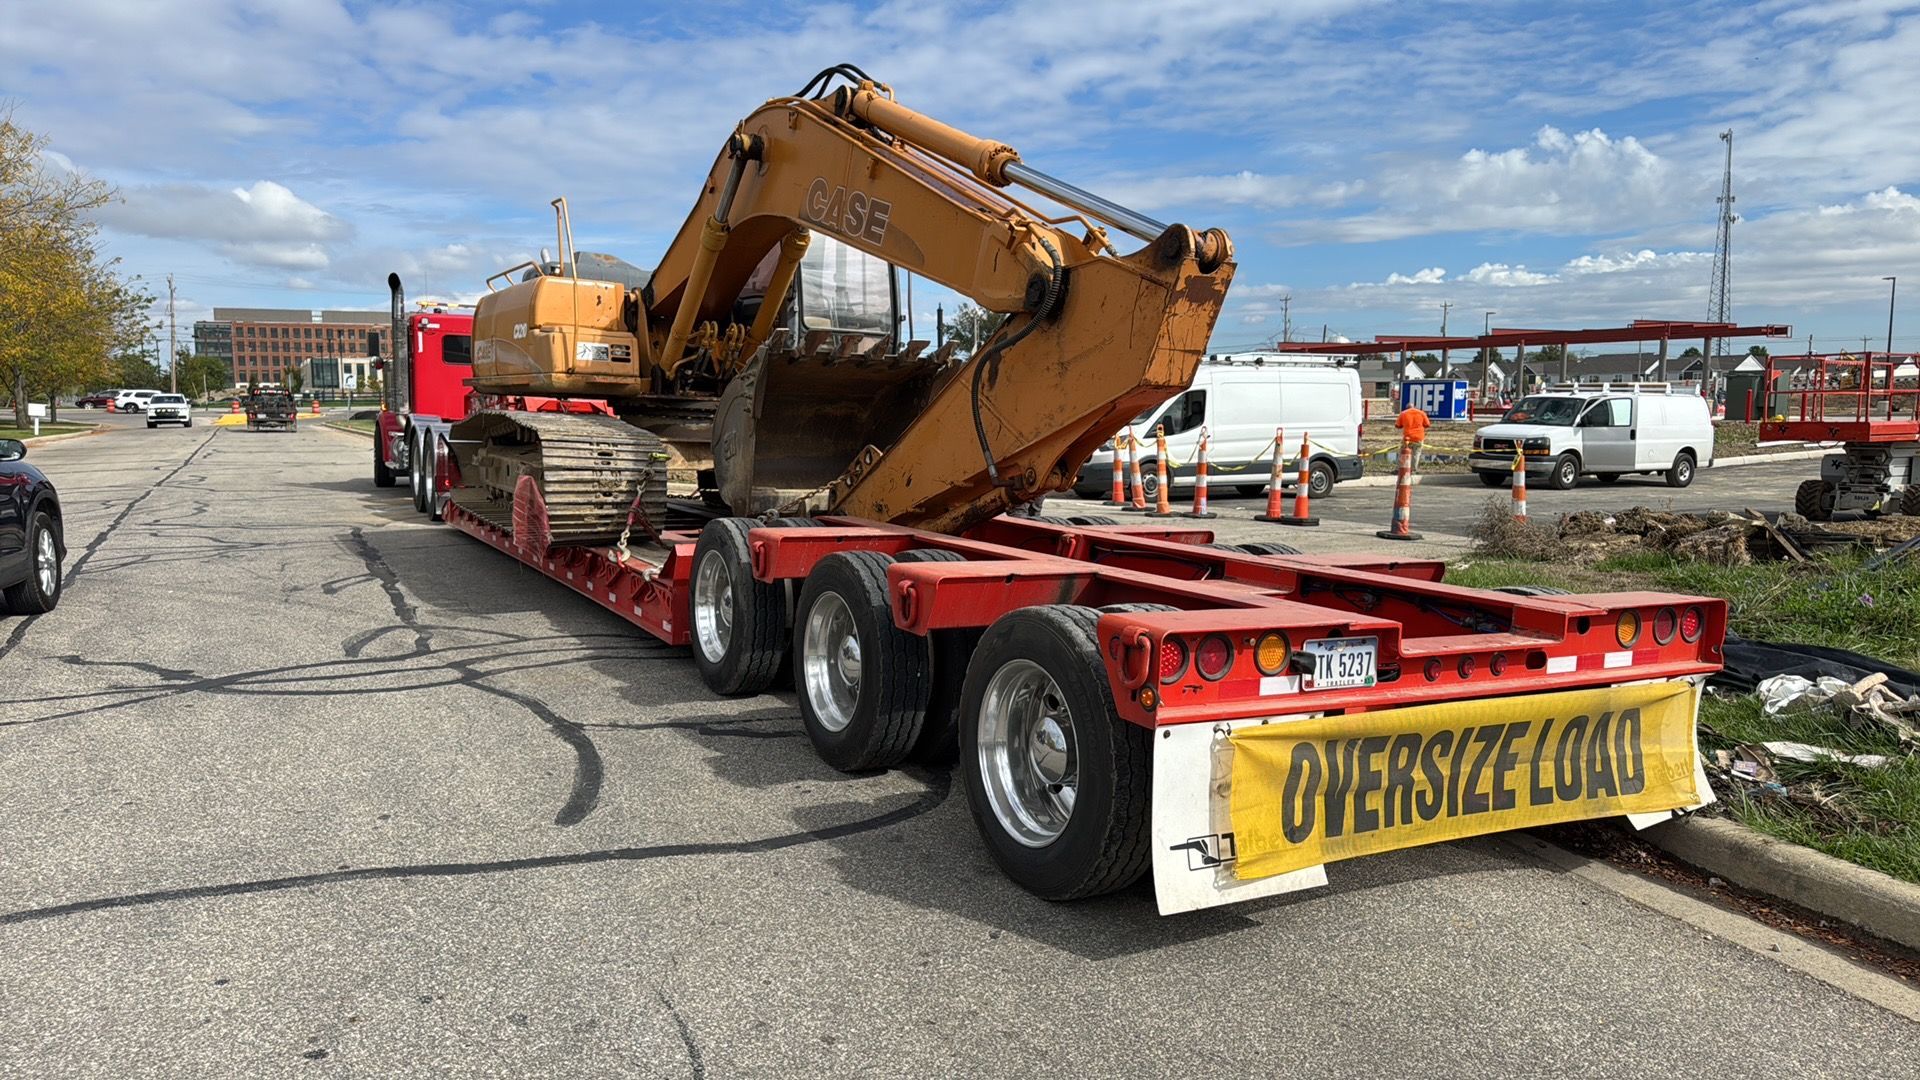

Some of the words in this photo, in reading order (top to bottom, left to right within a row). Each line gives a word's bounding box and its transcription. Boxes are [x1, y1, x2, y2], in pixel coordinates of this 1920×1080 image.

[806, 177, 892, 247] CASE
[1409, 384, 1446, 412] DEF
[1311, 654, 1333, 681] TK
[1339, 651, 1372, 678] 5237
[1326, 679, 1356, 688] TRAILER
[1281, 720, 1530, 844] OVERSIZE
[1530, 708, 1645, 806] LOAD
